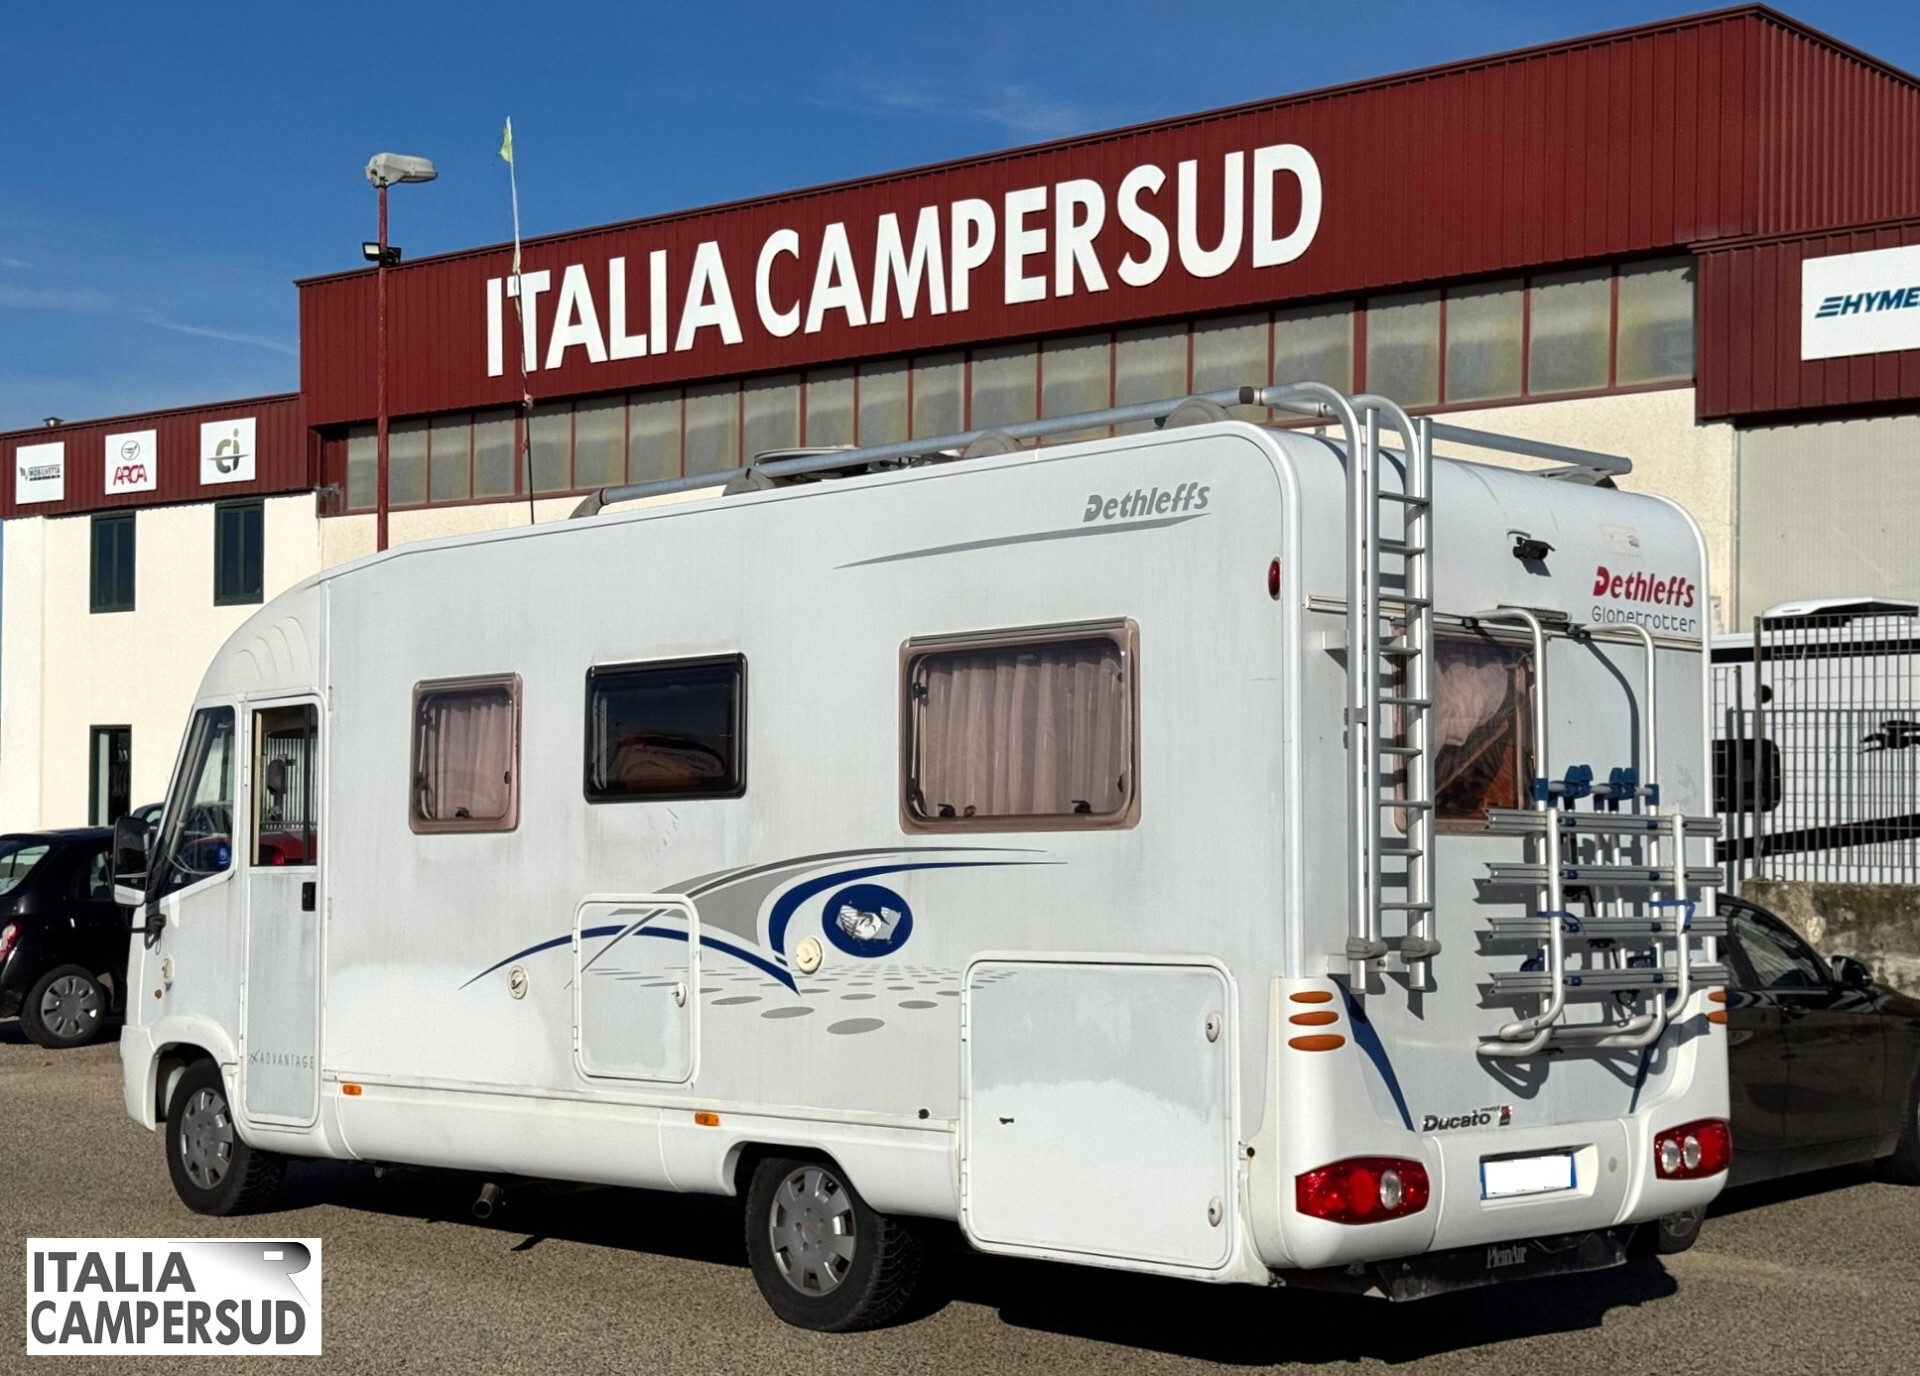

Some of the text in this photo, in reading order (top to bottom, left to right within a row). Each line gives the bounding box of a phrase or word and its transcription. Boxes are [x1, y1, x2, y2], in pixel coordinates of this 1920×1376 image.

[487, 143, 1323, 377] ITALIA CAMPERSUD
[113, 464, 147, 486] ARCA
[1083, 482, 1211, 522] Dethleffs
[1592, 565, 1696, 608] Dethleffs
[1423, 1110, 1491, 1132] Ducato
